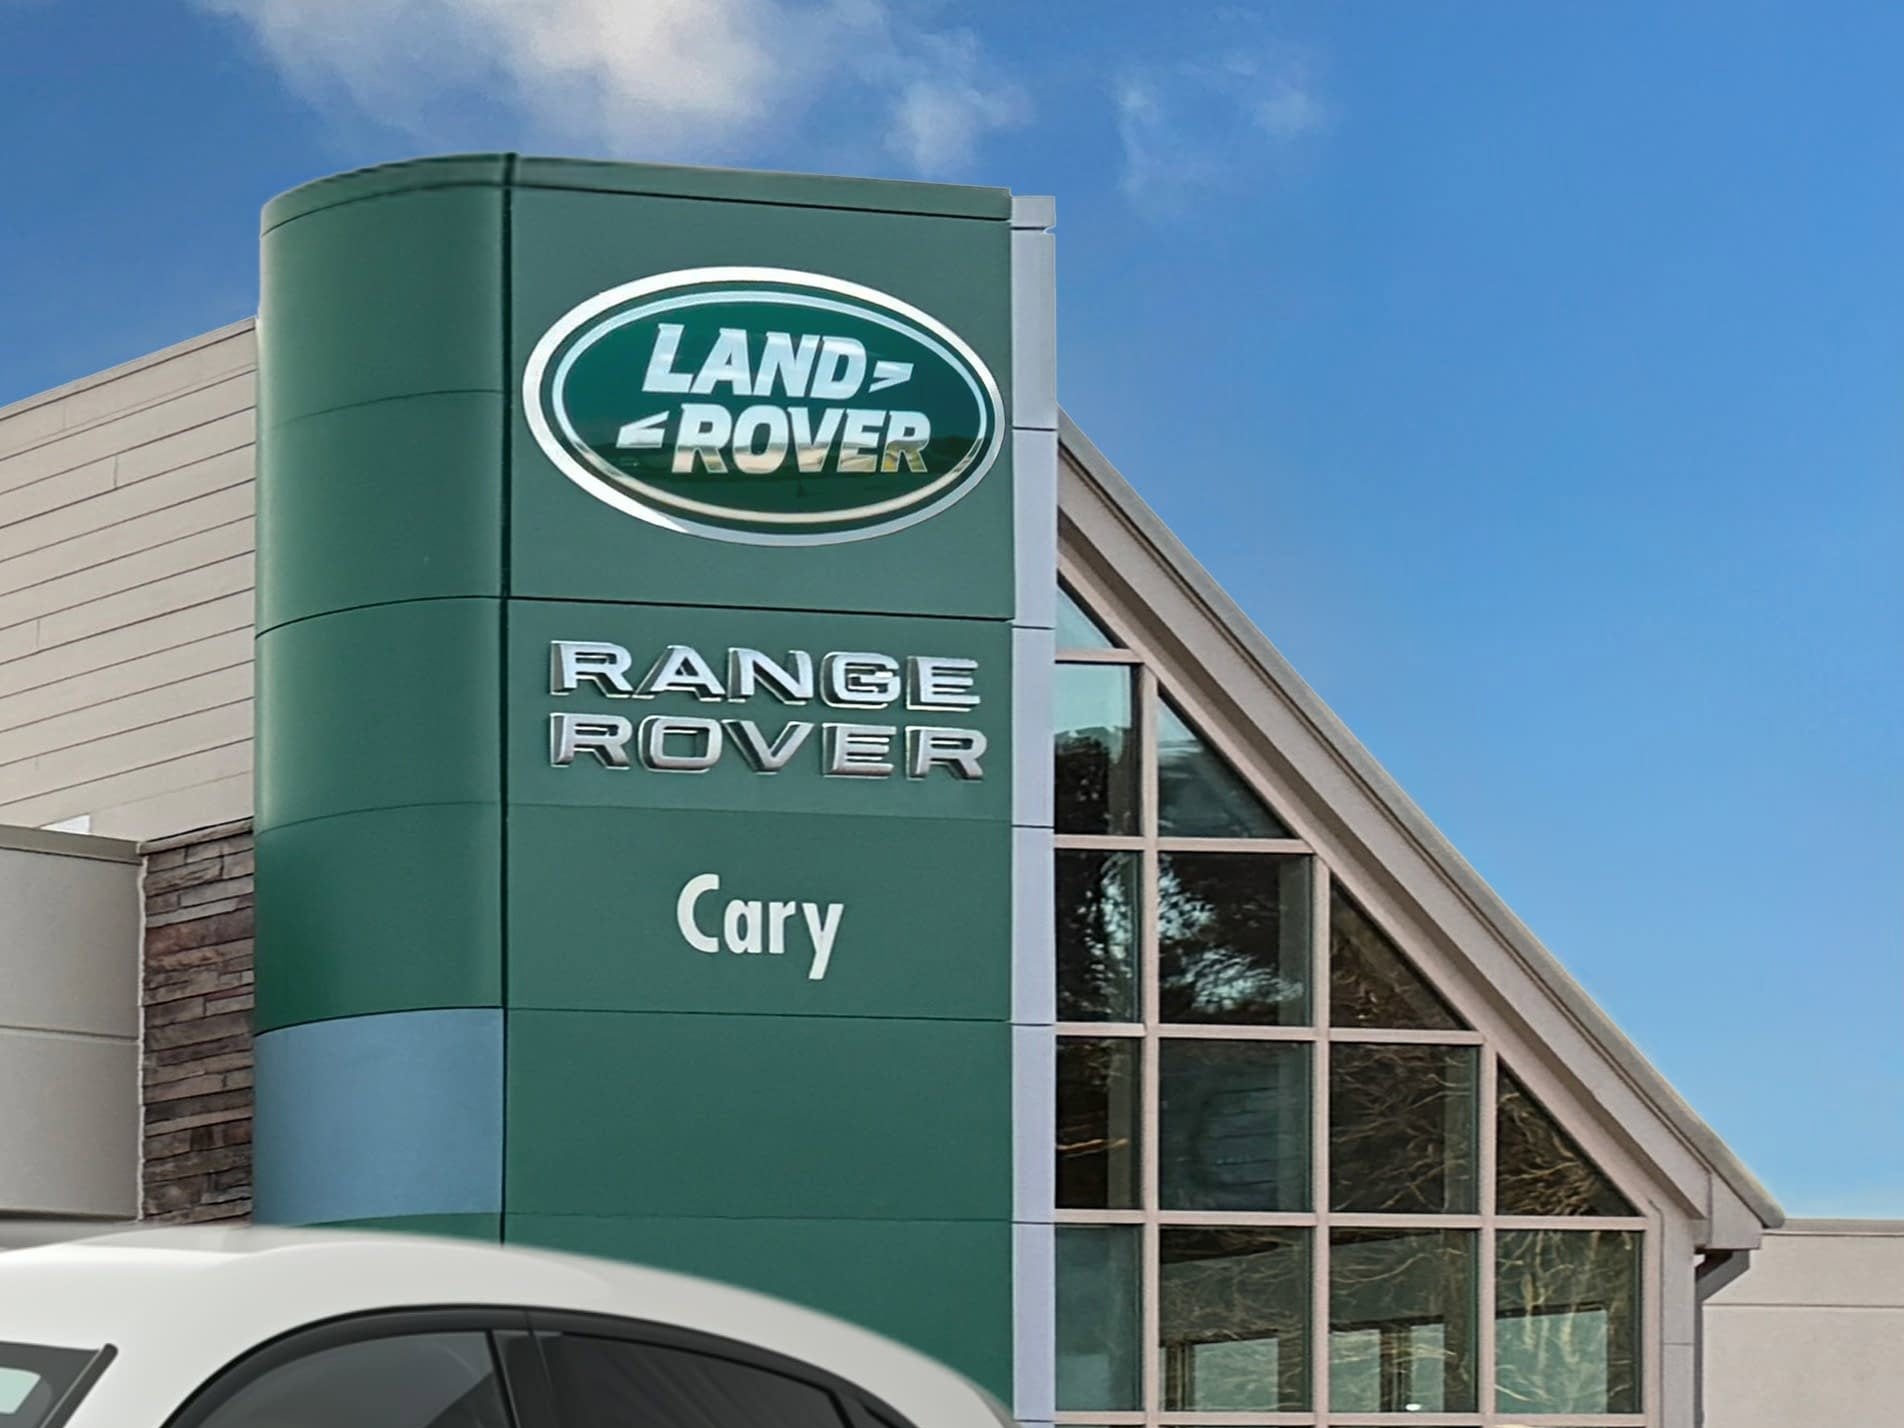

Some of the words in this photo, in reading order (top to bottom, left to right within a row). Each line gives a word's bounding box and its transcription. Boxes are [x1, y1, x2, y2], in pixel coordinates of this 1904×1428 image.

[642, 323, 870, 400] LAND
[671, 403, 932, 474] ROVER
[550, 640, 982, 711] RANGE
[550, 711, 987, 781] ROVER
[676, 873, 845, 980] Cary
